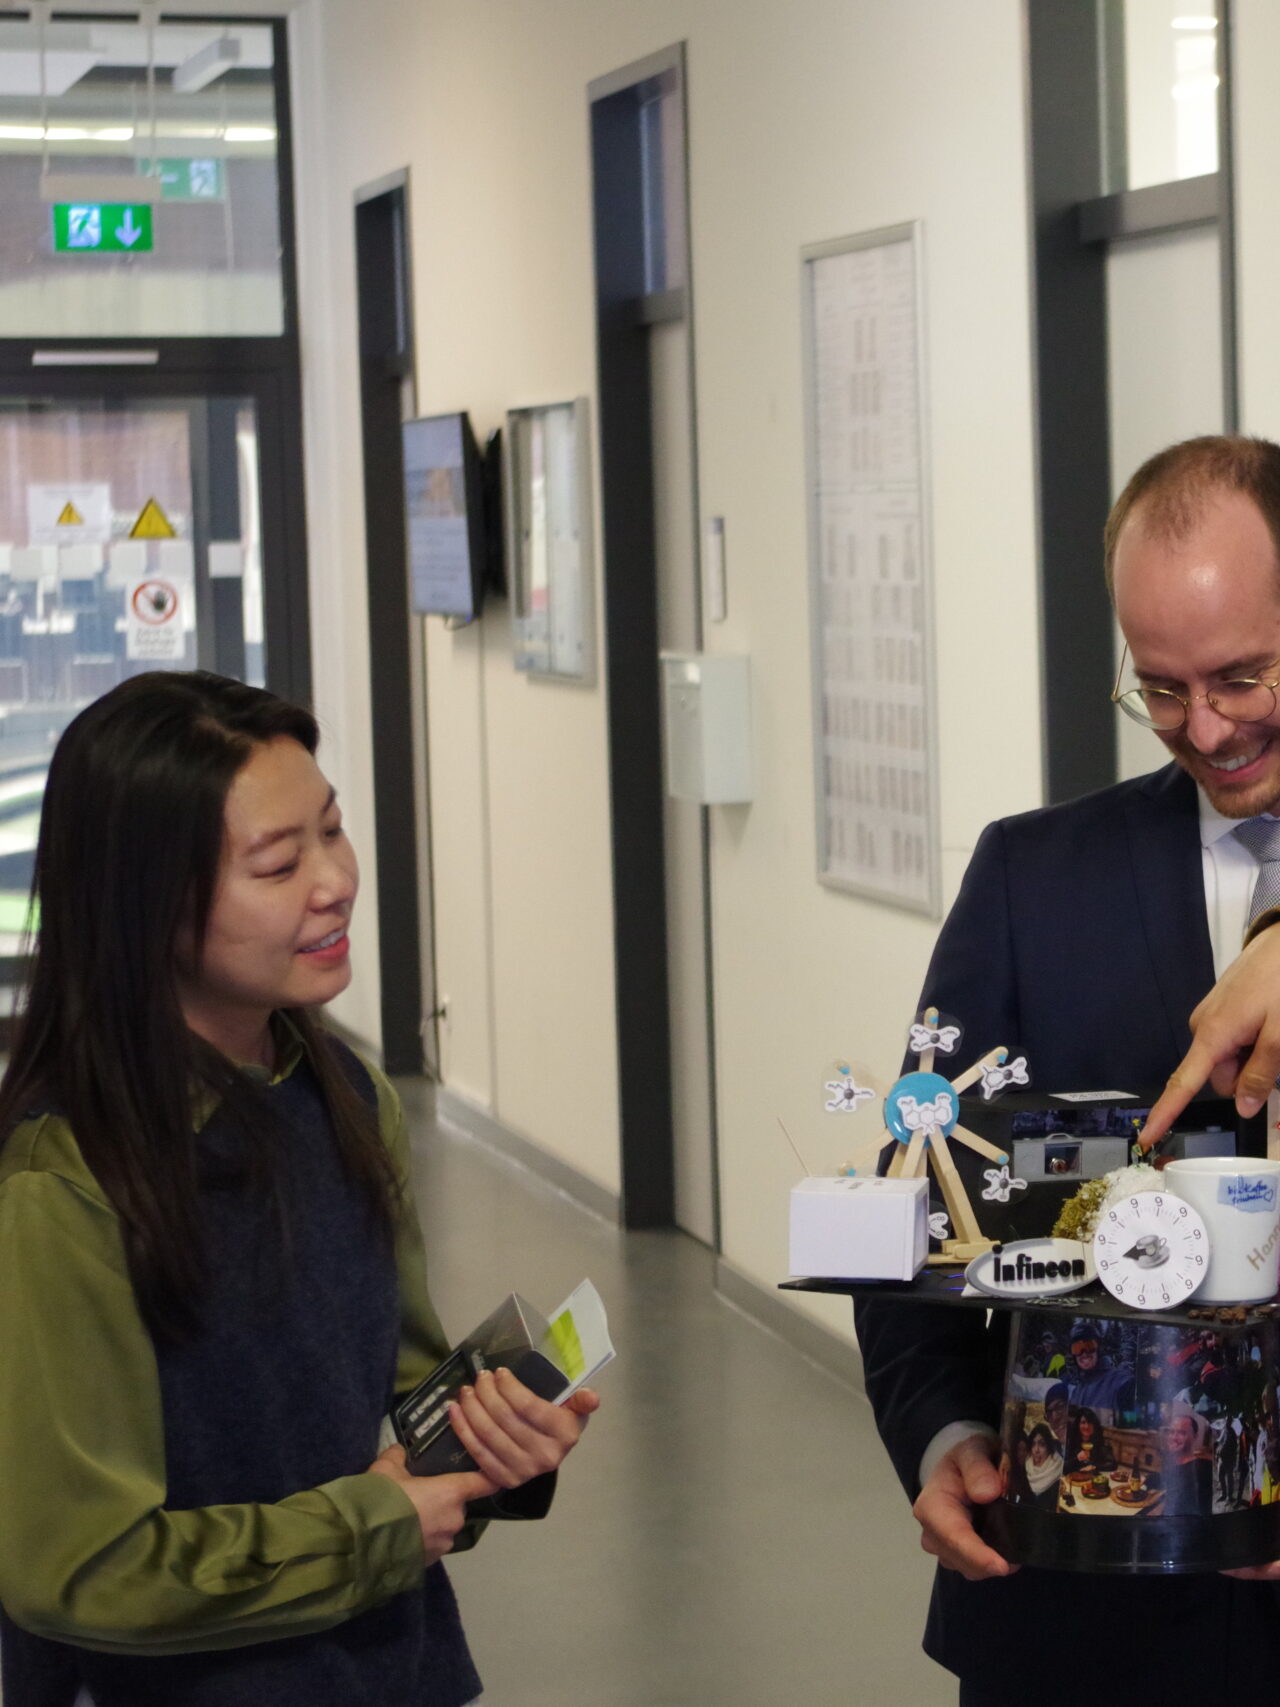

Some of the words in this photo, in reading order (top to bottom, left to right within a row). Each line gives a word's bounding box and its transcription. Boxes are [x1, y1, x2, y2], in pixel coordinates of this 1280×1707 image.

[1130, 1198, 1138, 1208] 9
[1155, 1196, 1163, 1207] 9
[1109, 1211, 1117, 1222] 9
[1179, 1207, 1187, 1217] 9
[1098, 1234, 1106, 1245] 9
[1193, 1229, 1201, 1240] 9
[1100, 1260, 1108, 1270] 9
[1195, 1255, 1203, 1266] 9
[1185, 1279, 1193, 1289] 9
[1115, 1284, 1123, 1295] 9
[1138, 1295, 1145, 1305] 9
[1162, 1293, 1170, 1303] 9
